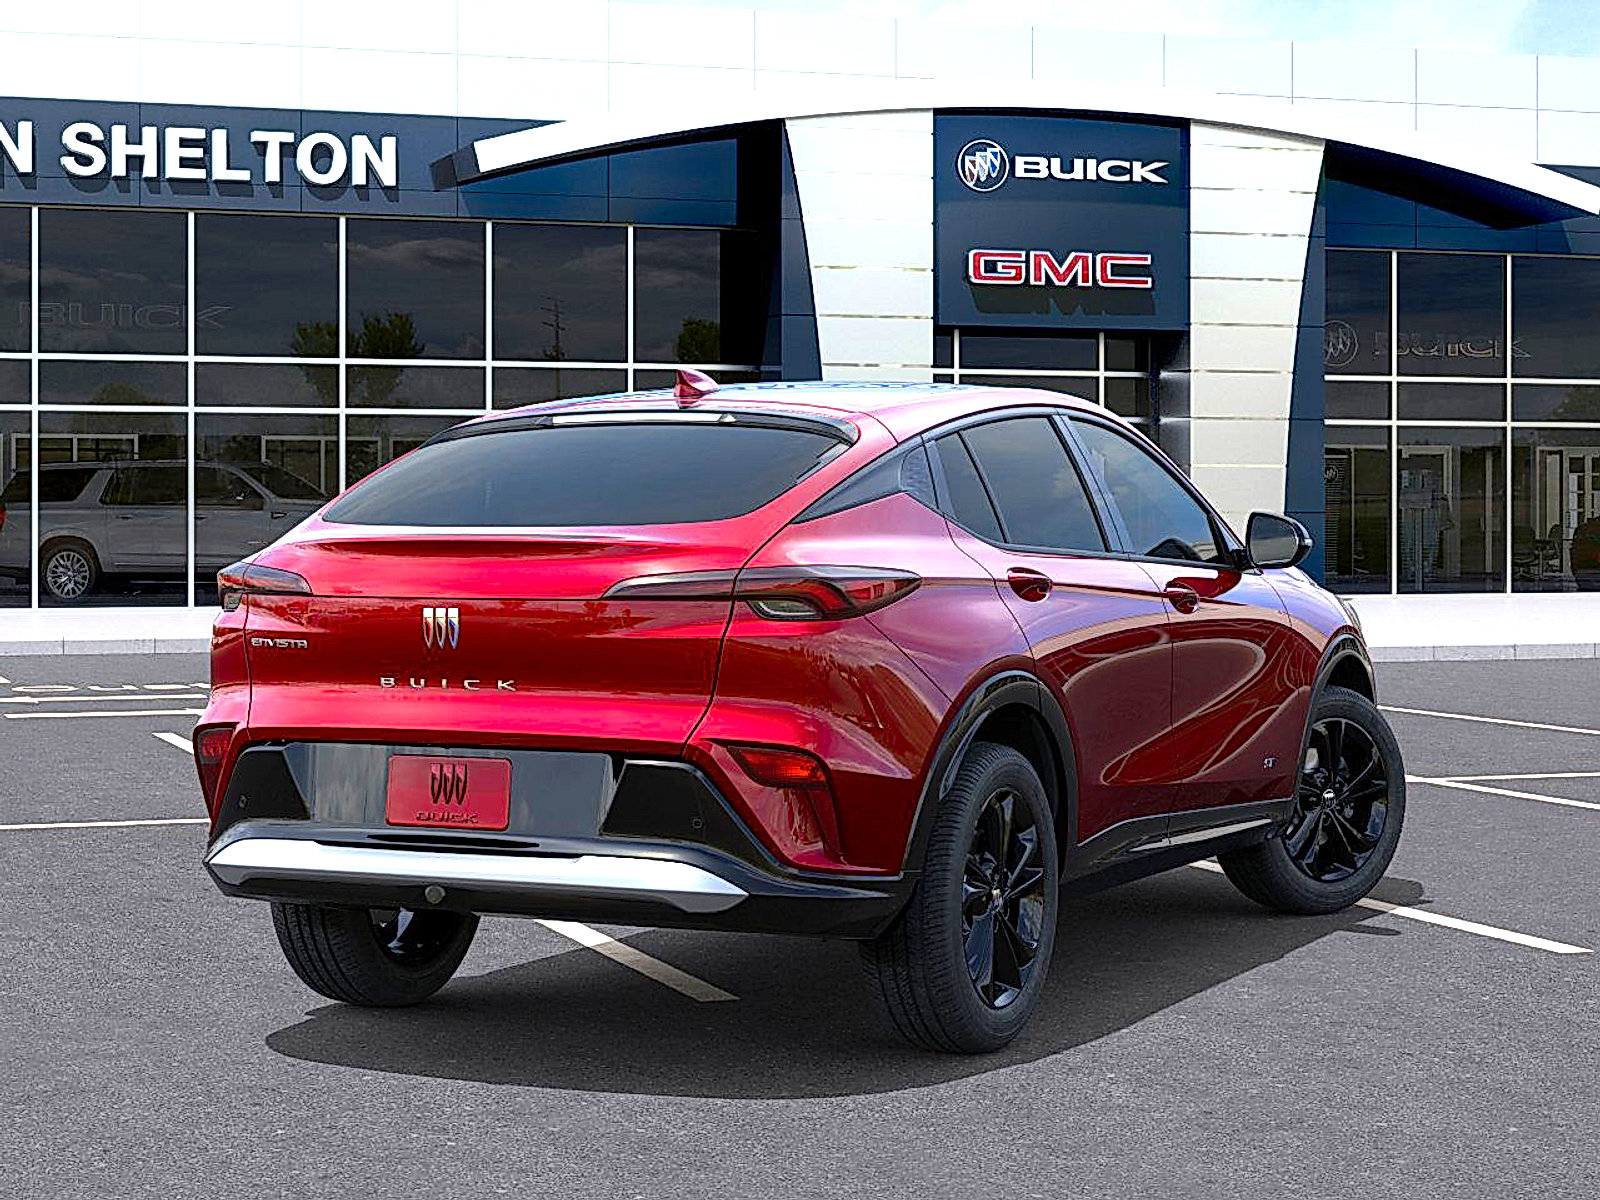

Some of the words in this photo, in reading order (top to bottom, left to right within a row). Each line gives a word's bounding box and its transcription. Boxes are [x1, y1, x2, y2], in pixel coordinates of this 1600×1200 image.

[59, 121, 397, 187] SHELTON
[1014, 154, 1170, 184] BUICK
[968, 249, 1153, 288] GMC
[380, 676, 517, 692] BUICK
[415, 811, 479, 824] BUICK
